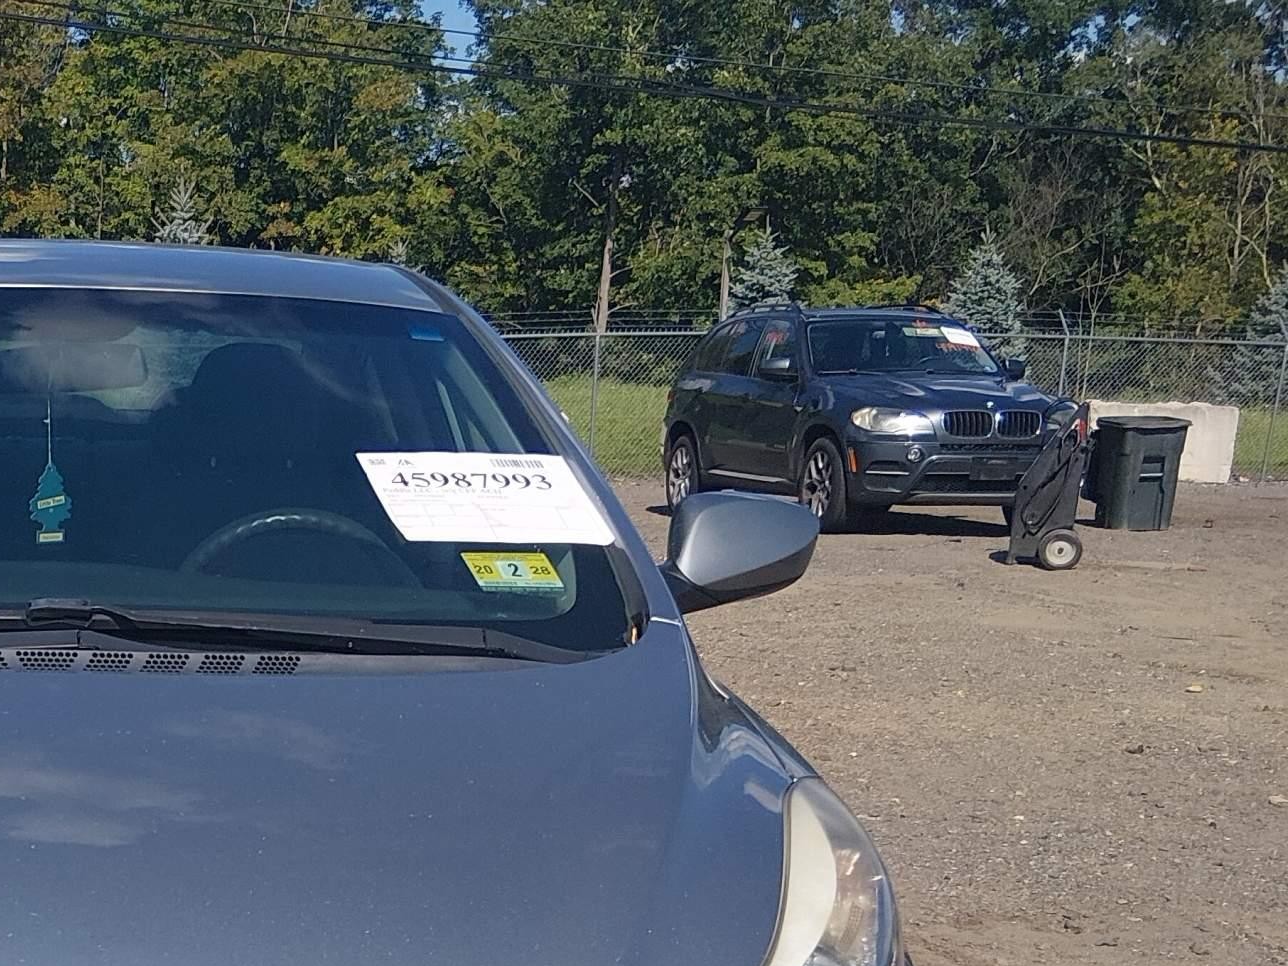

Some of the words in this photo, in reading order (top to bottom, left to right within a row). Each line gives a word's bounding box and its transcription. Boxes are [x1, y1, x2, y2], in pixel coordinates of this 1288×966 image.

[392, 471, 553, 491] 45987993
[472, 564, 494, 575] 20
[507, 562, 523, 578] 2
[529, 565, 552, 575] 28
